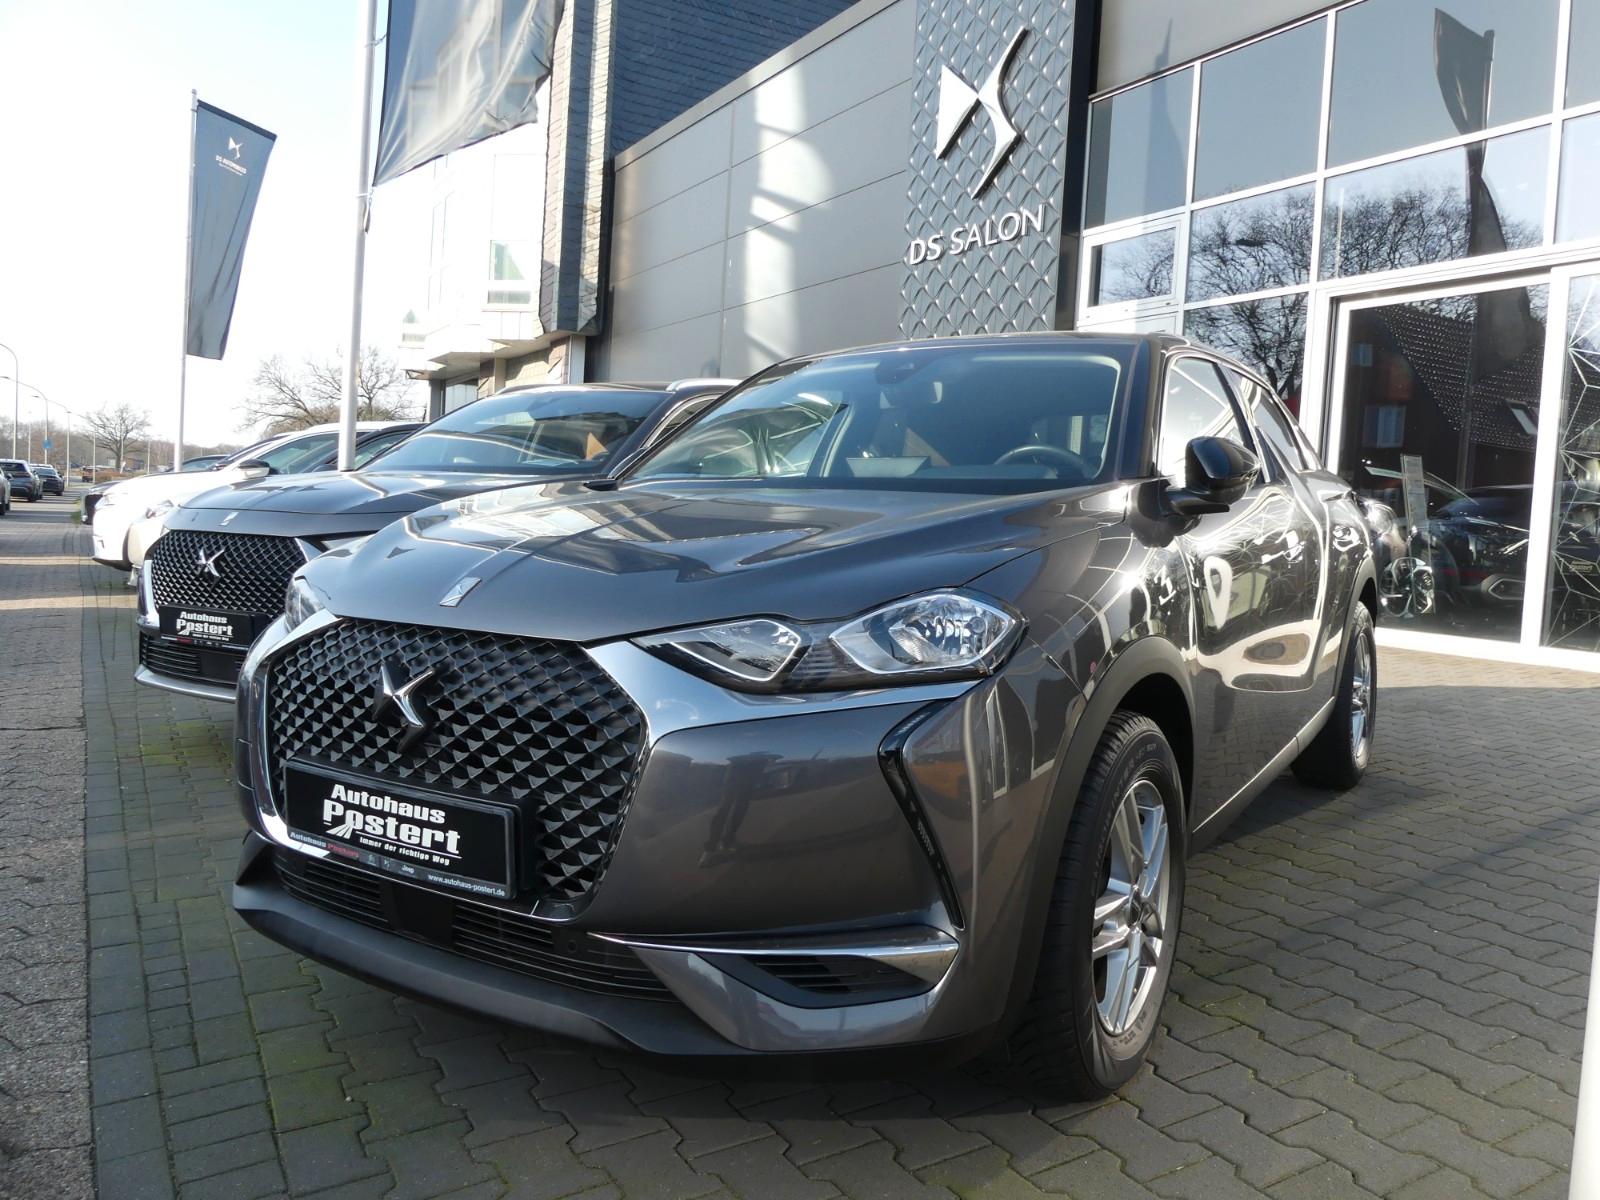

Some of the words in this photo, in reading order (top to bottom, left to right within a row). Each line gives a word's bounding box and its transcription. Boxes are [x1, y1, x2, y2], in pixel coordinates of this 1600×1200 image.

[909, 234, 943, 265] DS
[949, 203, 1045, 256] SALON
[176, 618, 233, 636] Postert
[180, 611, 227, 624] Autohaus
[331, 783, 446, 824] Autohaus
[323, 799, 460, 854] Postert
[360, 837, 382, 848] Immer
[384, 843, 397, 852] der
[399, 847, 430, 861] richtige
[432, 855, 450, 866] Weg
[427, 874, 506, 897] www.autohaus-postert.de
